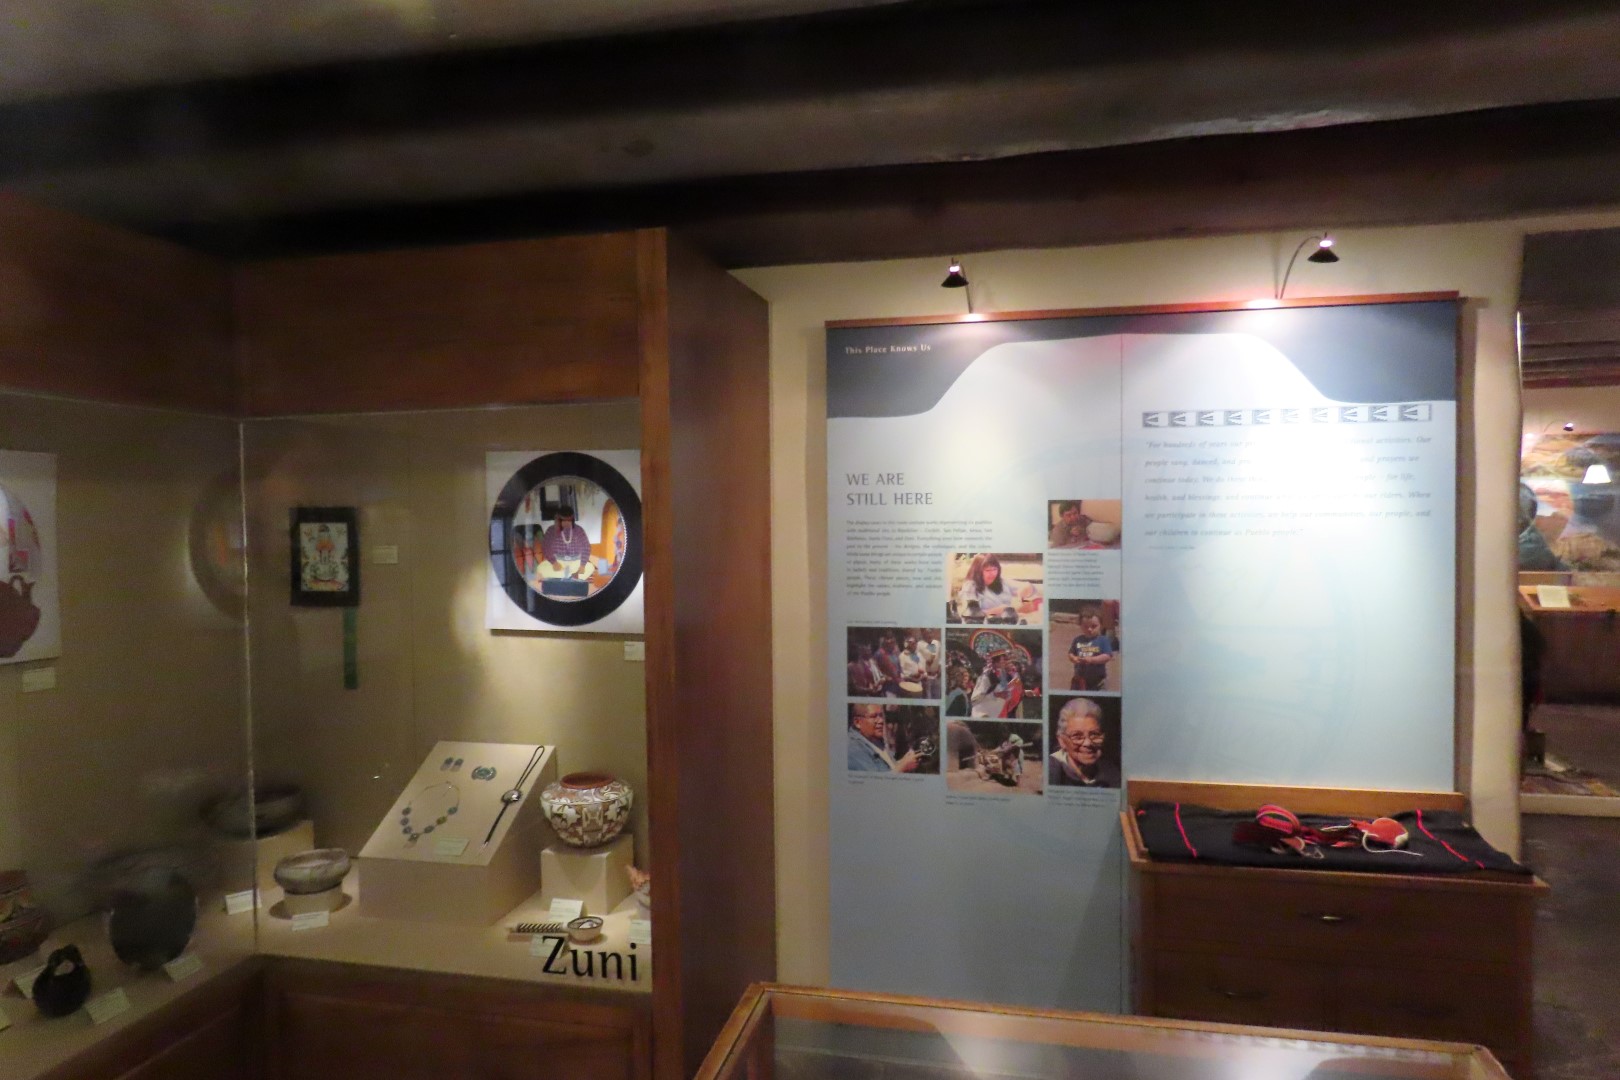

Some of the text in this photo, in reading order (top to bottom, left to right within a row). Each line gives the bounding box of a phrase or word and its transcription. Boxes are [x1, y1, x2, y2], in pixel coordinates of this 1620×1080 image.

[845, 344, 931, 354] This Place Knows Us
[846, 472, 905, 486] WE ARE
[846, 492, 933, 506] STILL HERE
[542, 935, 637, 981] Zuni
